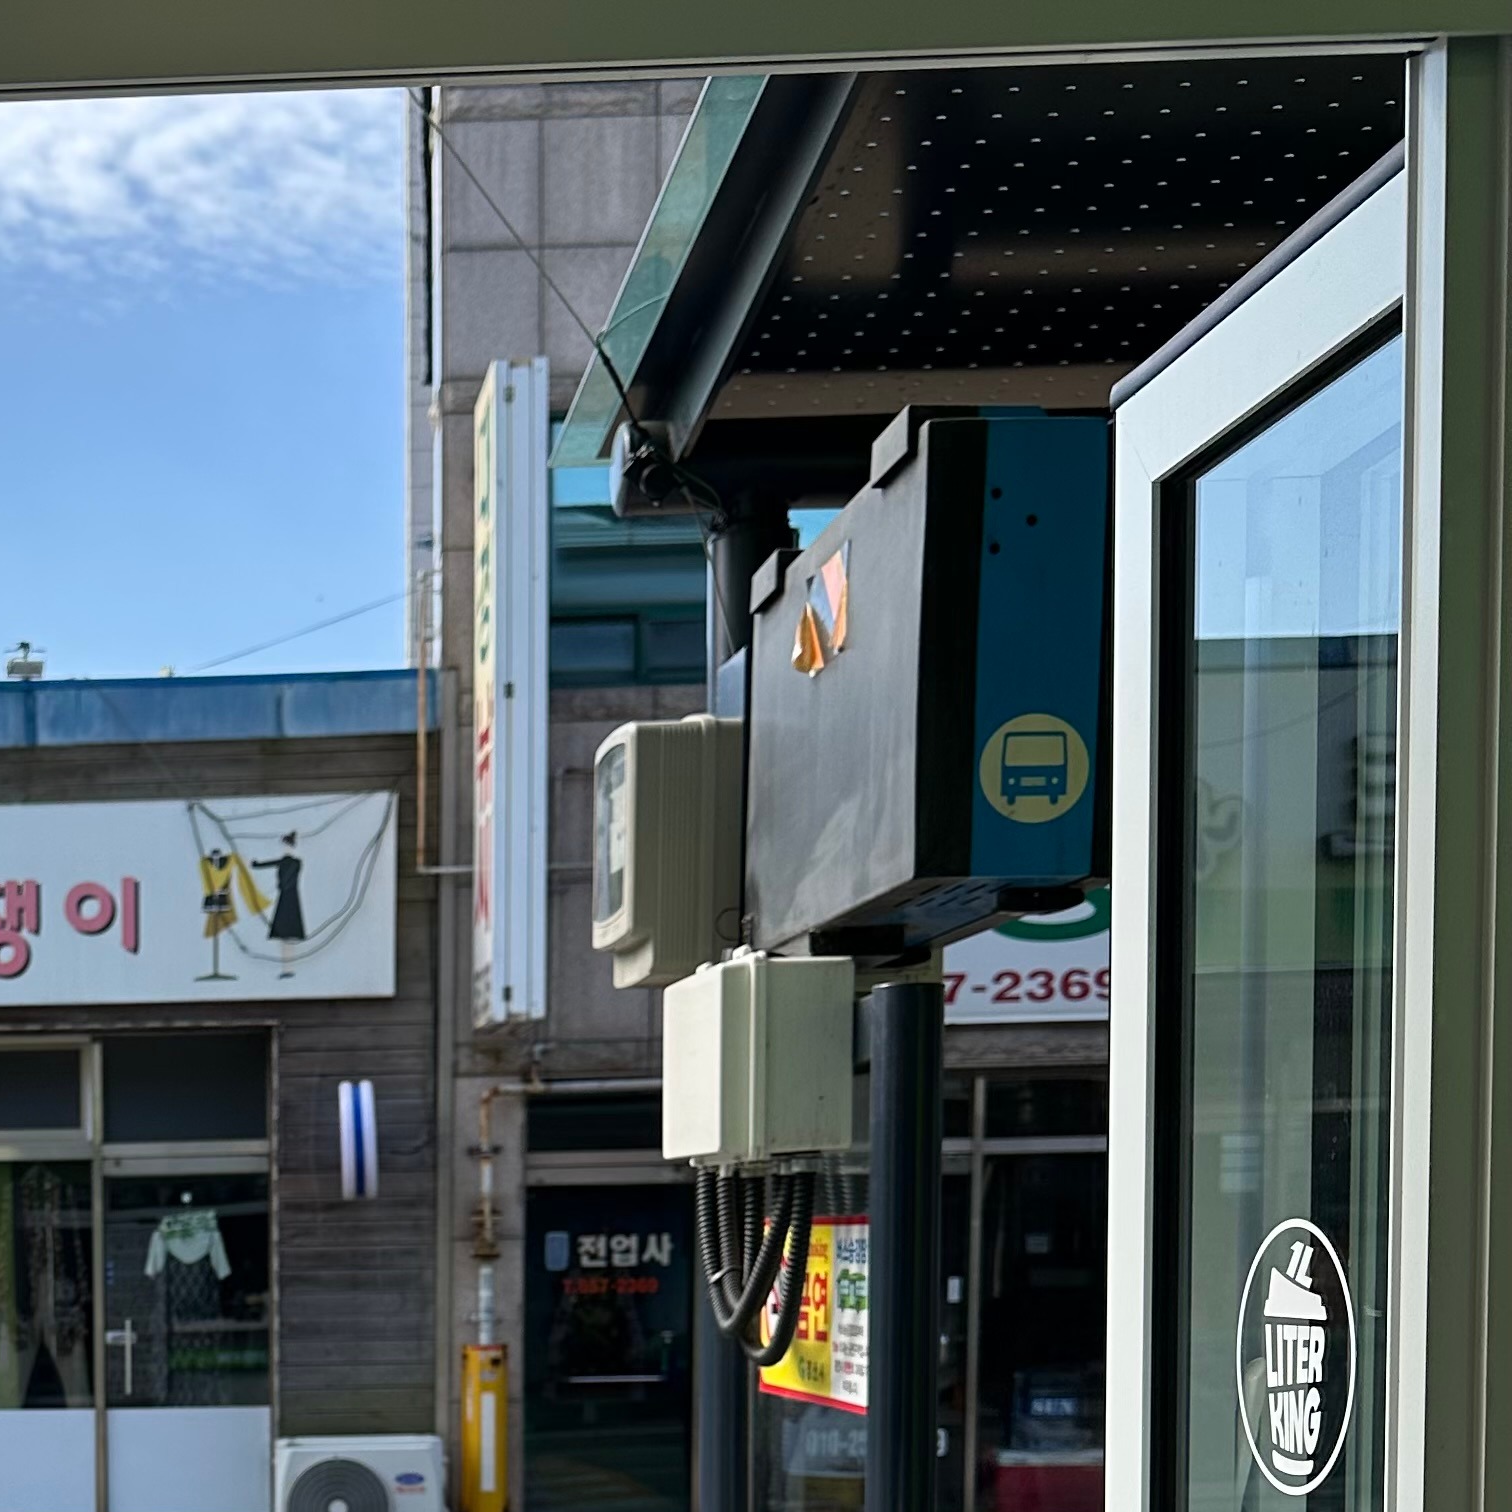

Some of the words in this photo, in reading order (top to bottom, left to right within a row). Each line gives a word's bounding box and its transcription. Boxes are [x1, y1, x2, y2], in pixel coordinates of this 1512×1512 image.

[1286, 1240, 1315, 1288] 1L
[1264, 1324, 1326, 1389] LITER
[1268, 1386, 1322, 1457] KING
